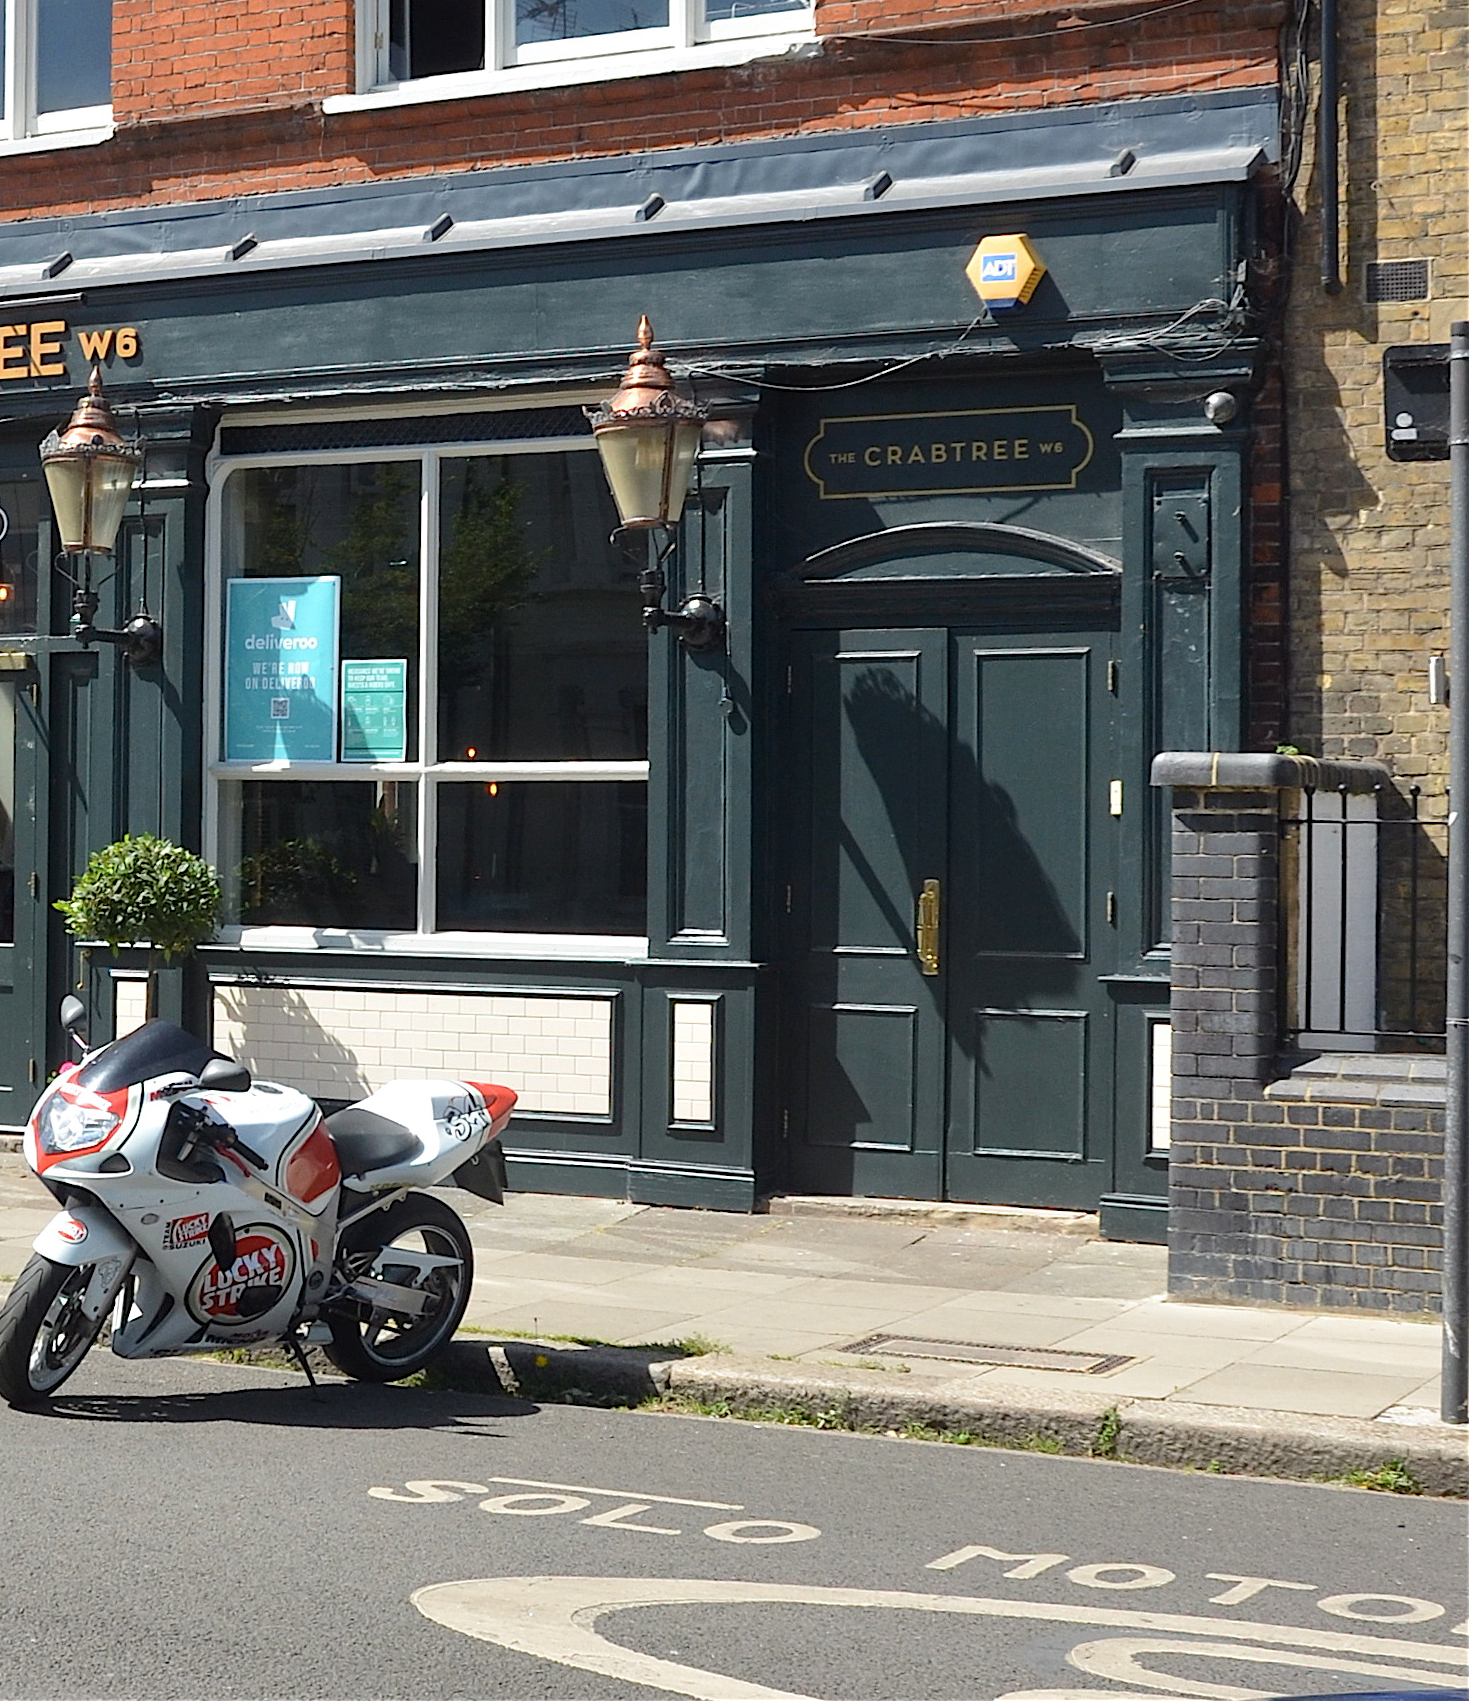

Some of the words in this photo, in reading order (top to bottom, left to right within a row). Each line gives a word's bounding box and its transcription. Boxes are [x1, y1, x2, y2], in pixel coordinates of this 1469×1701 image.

[983, 260, 1016, 277] ADT
[77, 327, 138, 361] W6
[829, 453, 856, 465] THE
[863, 439, 1030, 467] CRABTREE
[1039, 442, 1064, 454] W6
[245, 634, 318, 650] deliveroo
[252, 661, 284, 675] WE'RE
[287, 661, 310, 675] NOW
[245, 677, 259, 690] ON
[262, 676, 316, 690] DELIVEROO
[177, 1214, 207, 1234] LUCKY
[169, 1238, 206, 1250] SUZUKI
[203, 1244, 280, 1293] LUCKY
[367, 1479, 822, 1545] SOLO
[924, 1545, 1469, 1635] MOTO
